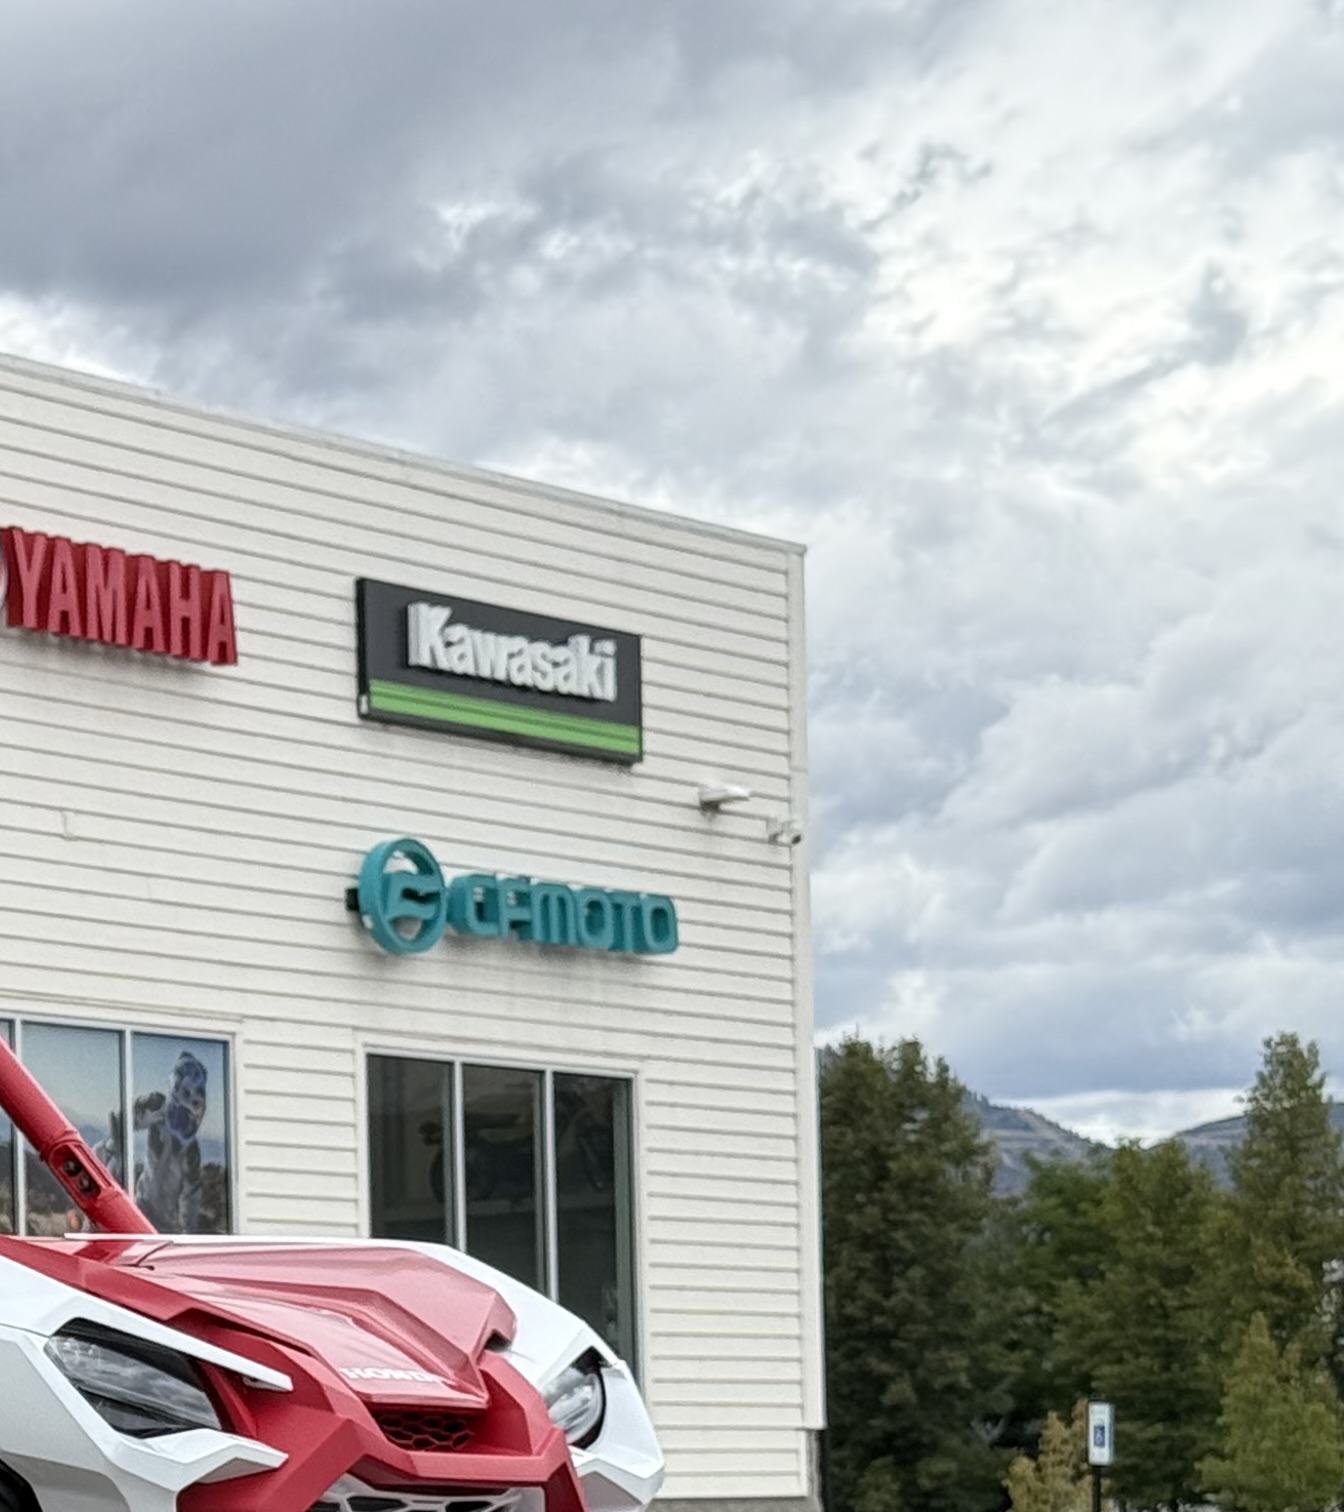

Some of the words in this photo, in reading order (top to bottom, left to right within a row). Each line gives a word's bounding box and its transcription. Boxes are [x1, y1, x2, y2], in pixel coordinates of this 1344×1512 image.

[6, 525, 238, 665] YAMAHA
[407, 601, 617, 702] Kawasaki
[447, 873, 678, 954] CFMOTO
